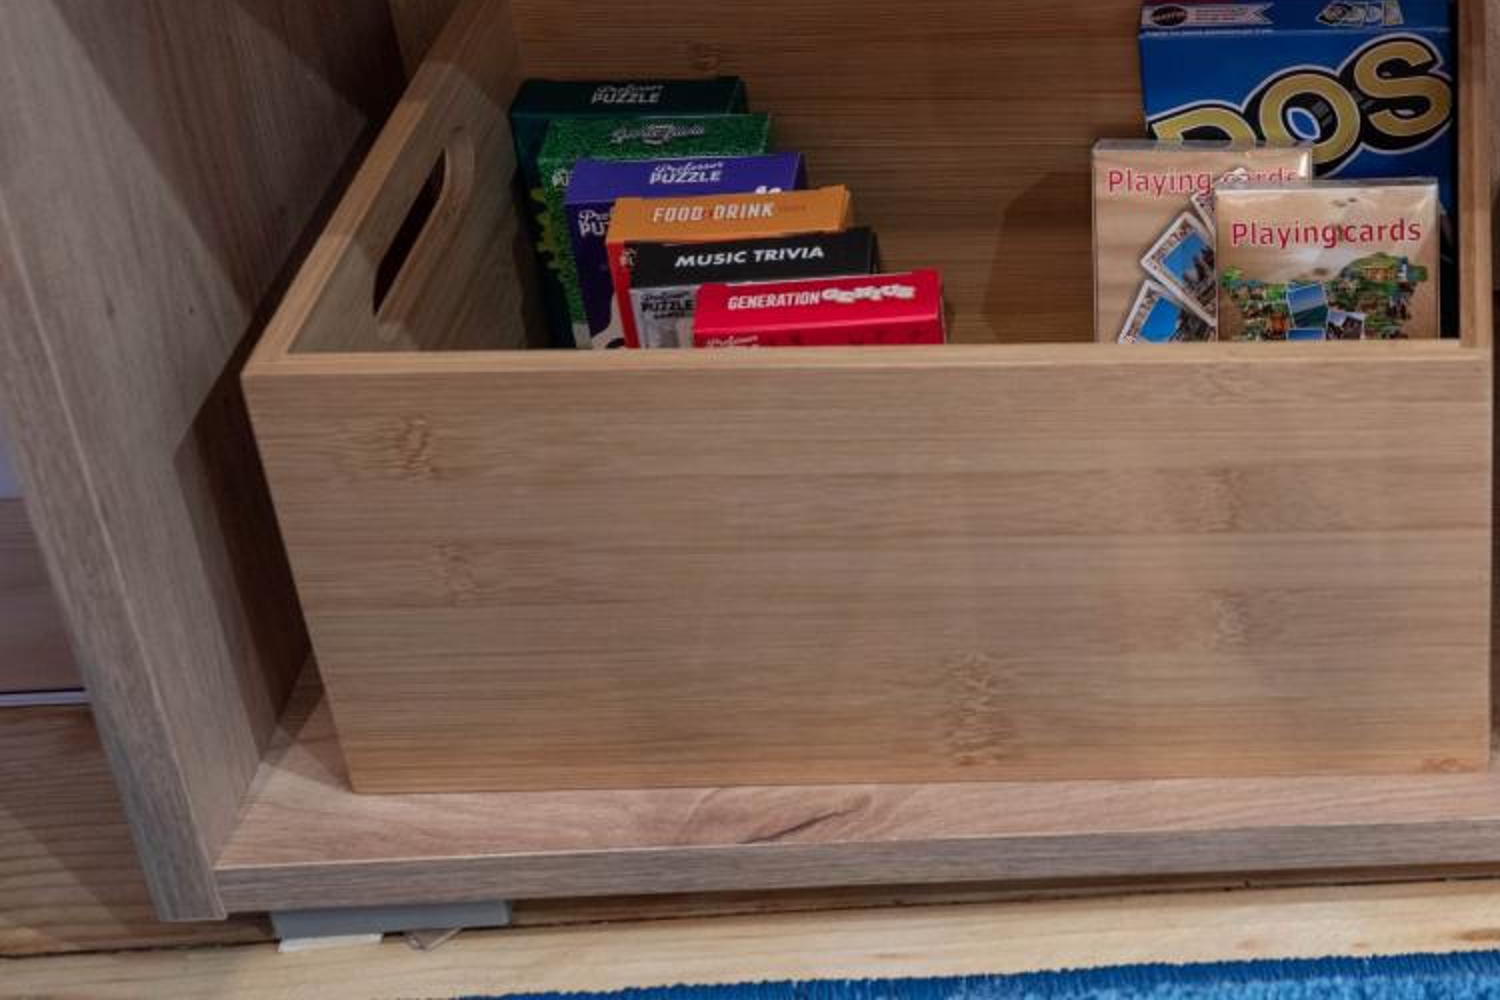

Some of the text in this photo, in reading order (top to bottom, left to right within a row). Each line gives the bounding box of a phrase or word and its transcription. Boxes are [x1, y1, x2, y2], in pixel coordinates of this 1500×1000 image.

[591, 89, 661, 104] PUZZLE
[650, 170, 722, 185] PUZZLE
[1108, 169, 1211, 198] Playing
[653, 206, 705, 223] FOOD
[713, 202, 775, 219] DRINK
[1232, 218, 1422, 249] Playing cards
[675, 246, 825, 268] MUSIC TRIVIA
[727, 291, 820, 311] GENERATION
